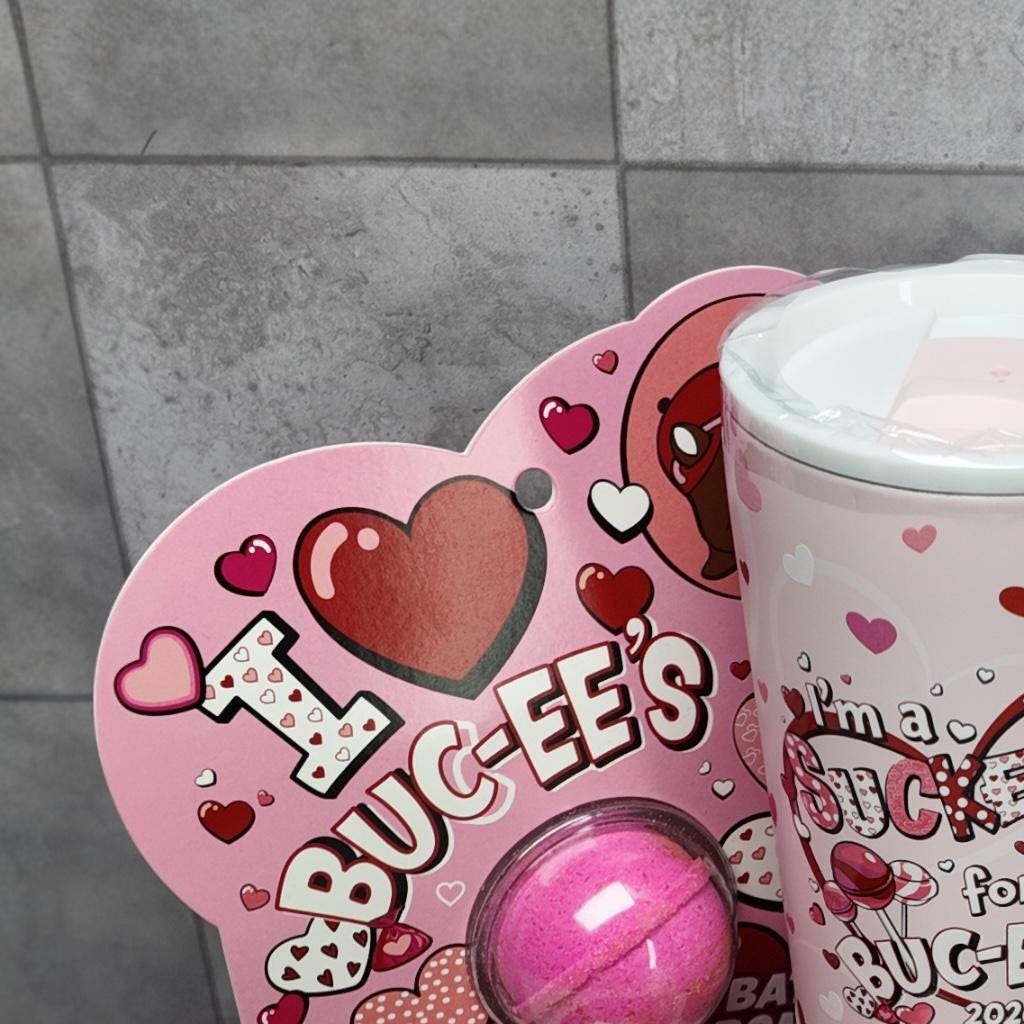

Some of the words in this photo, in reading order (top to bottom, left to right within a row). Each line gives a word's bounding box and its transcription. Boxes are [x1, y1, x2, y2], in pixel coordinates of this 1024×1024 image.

[200, 611, 404, 798] I
[805, 676, 886, 741] I'm
[897, 701, 938, 745] a
[275, 614, 716, 928] BUC-EE'S
[726, 972, 800, 1012] BA
